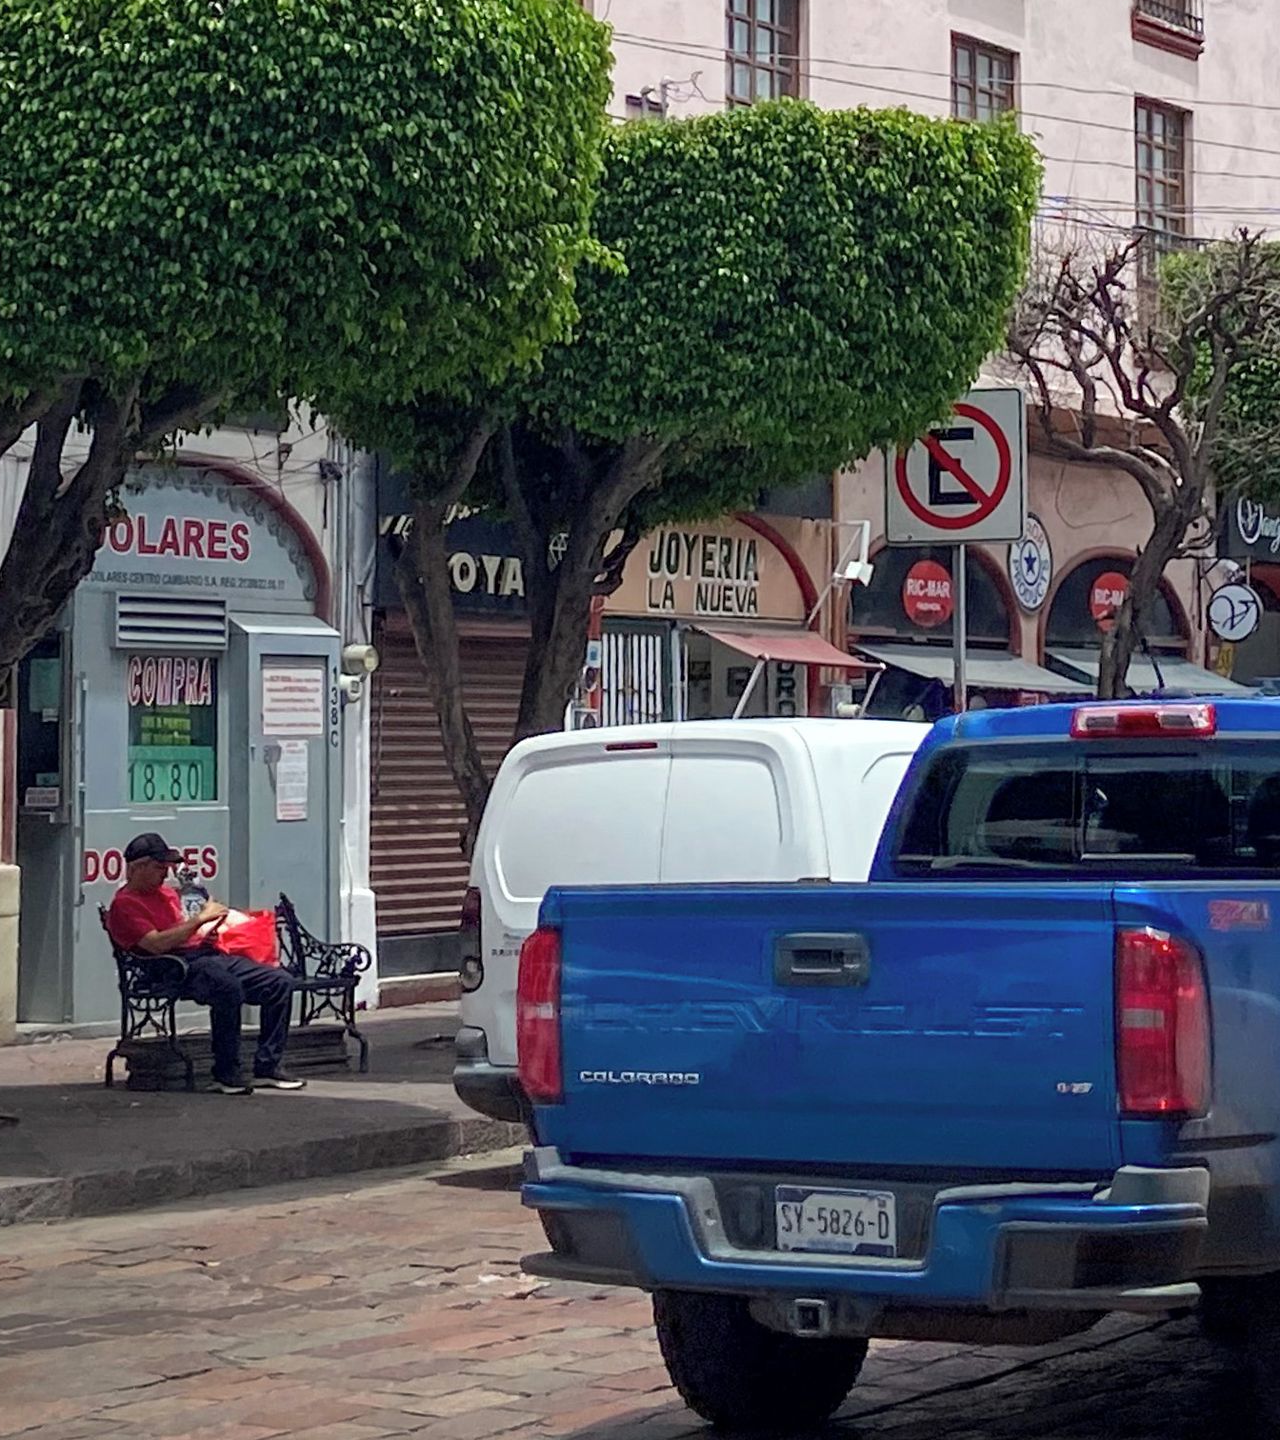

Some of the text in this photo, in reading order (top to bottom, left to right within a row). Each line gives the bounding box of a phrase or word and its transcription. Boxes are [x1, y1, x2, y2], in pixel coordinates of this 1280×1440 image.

[98, 515, 251, 561] OLARES
[648, 529, 760, 587] JOYERIA
[647, 578, 759, 617] LA NUEVA
[907, 578, 951, 598] RIC-MAR
[127, 656, 213, 707] COMPRA
[128, 762, 200, 801] 18.80
[580, 1071, 700, 1085] COLORADO
[782, 1203, 889, 1240] SY-5826-D
